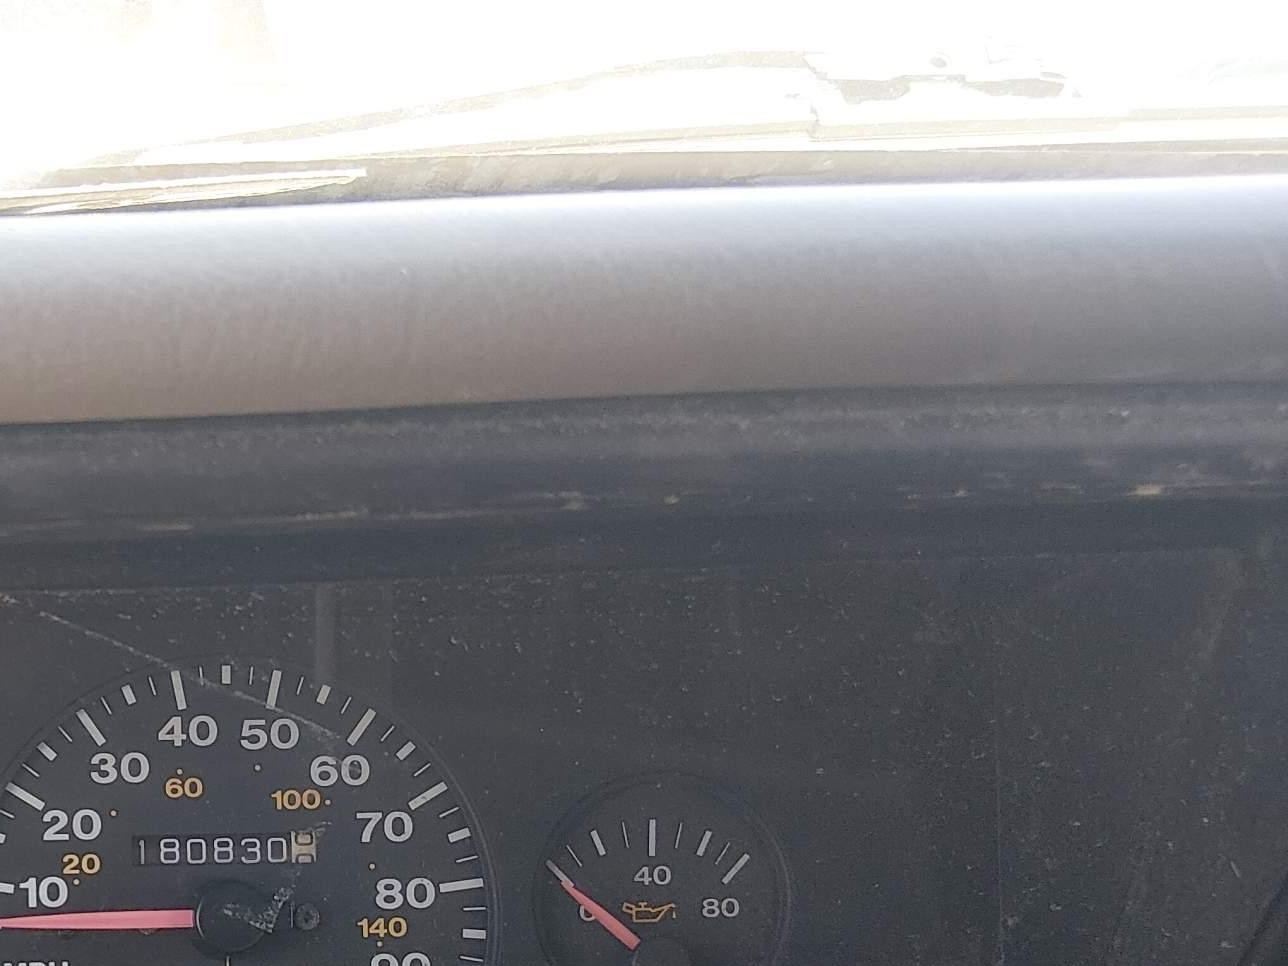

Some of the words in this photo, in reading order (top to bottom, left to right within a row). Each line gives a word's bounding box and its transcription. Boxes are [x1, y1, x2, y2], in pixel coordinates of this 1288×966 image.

[158, 716, 218, 747] 40
[240, 718, 300, 750] 50
[90, 752, 150, 784] 30
[310, 755, 370, 787] 60
[165, 777, 203, 799] 60
[271, 790, 321, 810] 100
[42, 809, 103, 841] 20
[356, 811, 414, 843] 70
[62, 853, 101, 875] 20
[633, 865, 672, 886] 40
[18, 878, 69, 908] 10
[375, 878, 436, 909] 80
[701, 898, 740, 918] 80
[358, 917, 407, 939] 140
